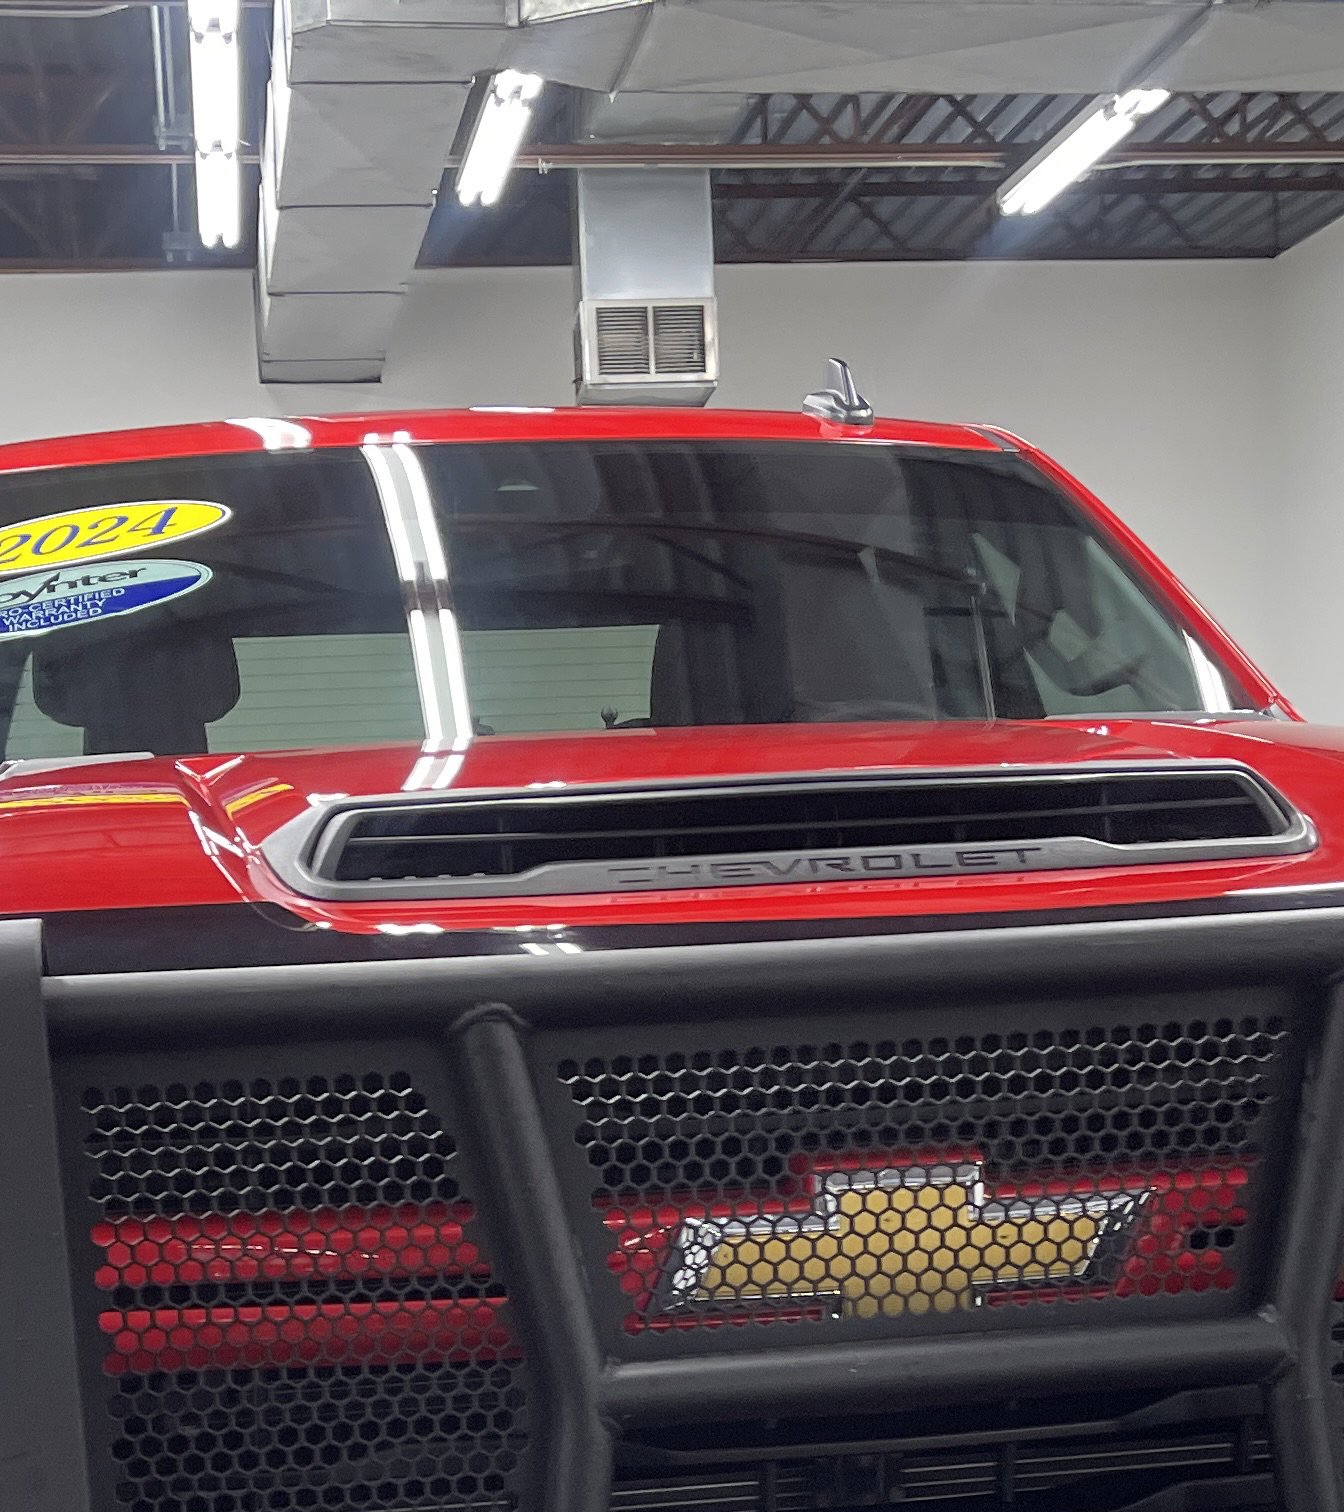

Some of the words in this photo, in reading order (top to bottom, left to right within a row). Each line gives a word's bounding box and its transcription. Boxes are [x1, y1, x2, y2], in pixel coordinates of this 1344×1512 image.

[2, 599, 106, 625] WARRANTY
[8, 606, 102, 632] INCLUDED
[606, 847, 1042, 884] CHEVROLET
